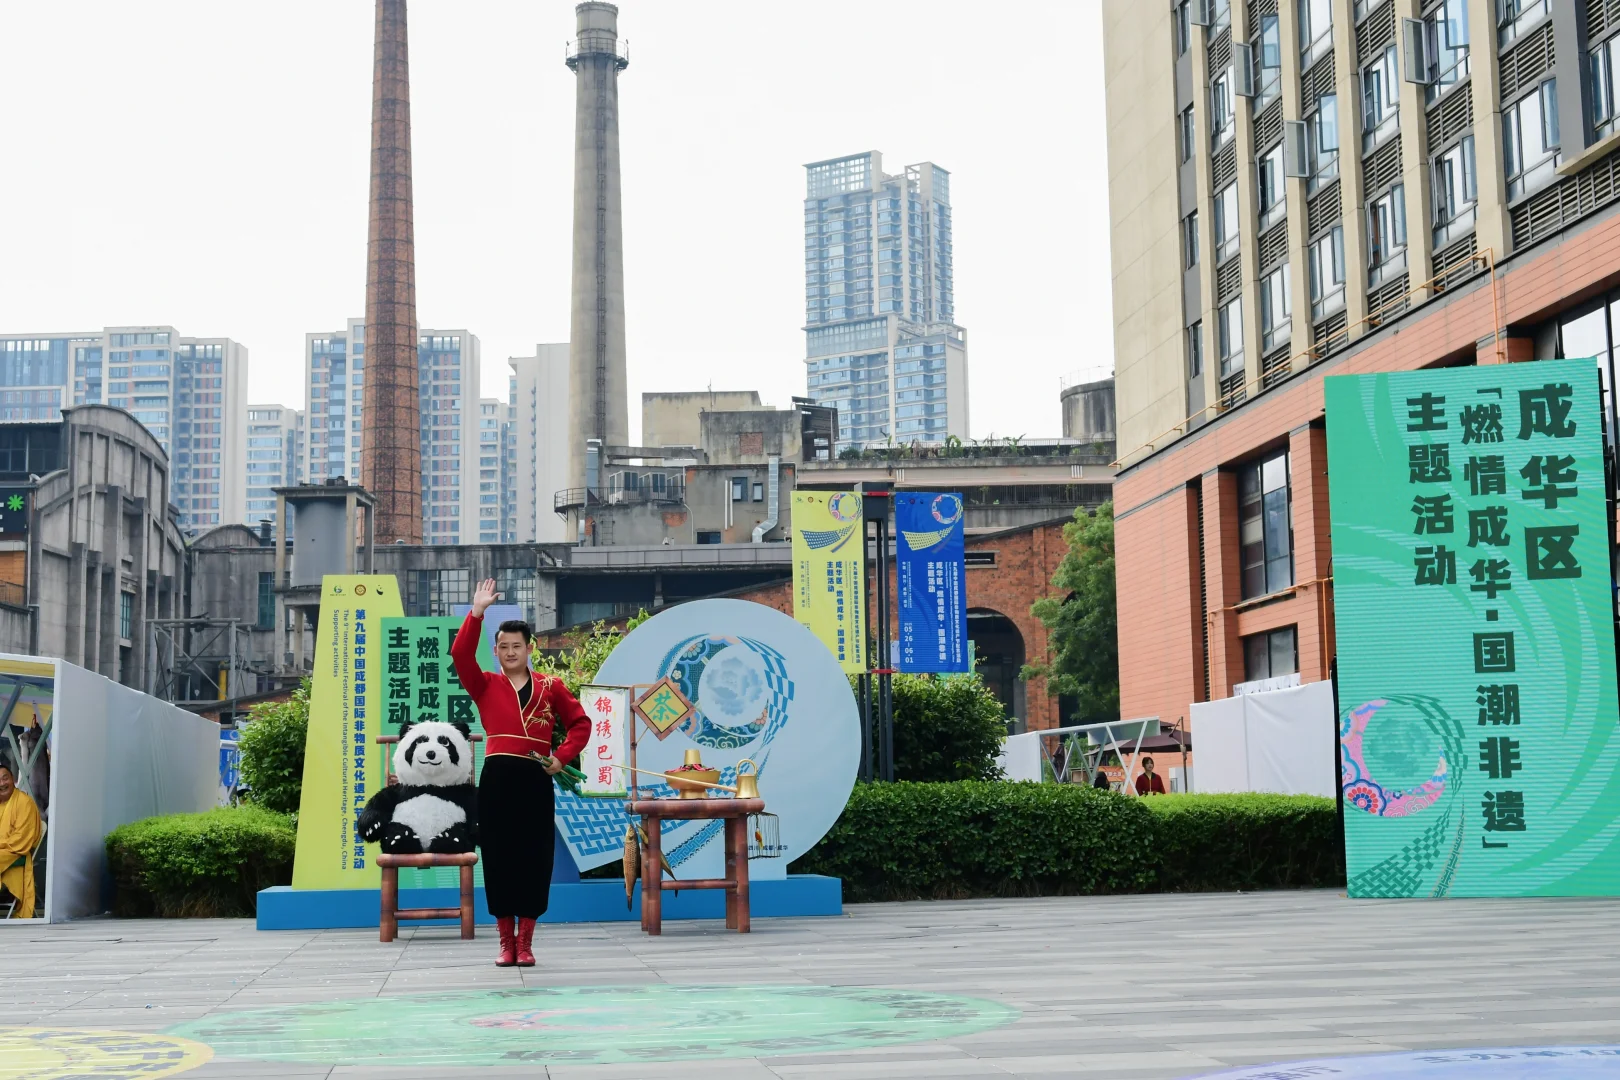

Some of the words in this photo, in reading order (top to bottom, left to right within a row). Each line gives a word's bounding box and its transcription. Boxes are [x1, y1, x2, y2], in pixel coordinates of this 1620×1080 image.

[1406, 392, 1457, 586] 主题活动
[1516, 383, 1582, 580] 成华区
[388, 626, 411, 724] 主题活动
[648, 690, 679, 722] 茶
